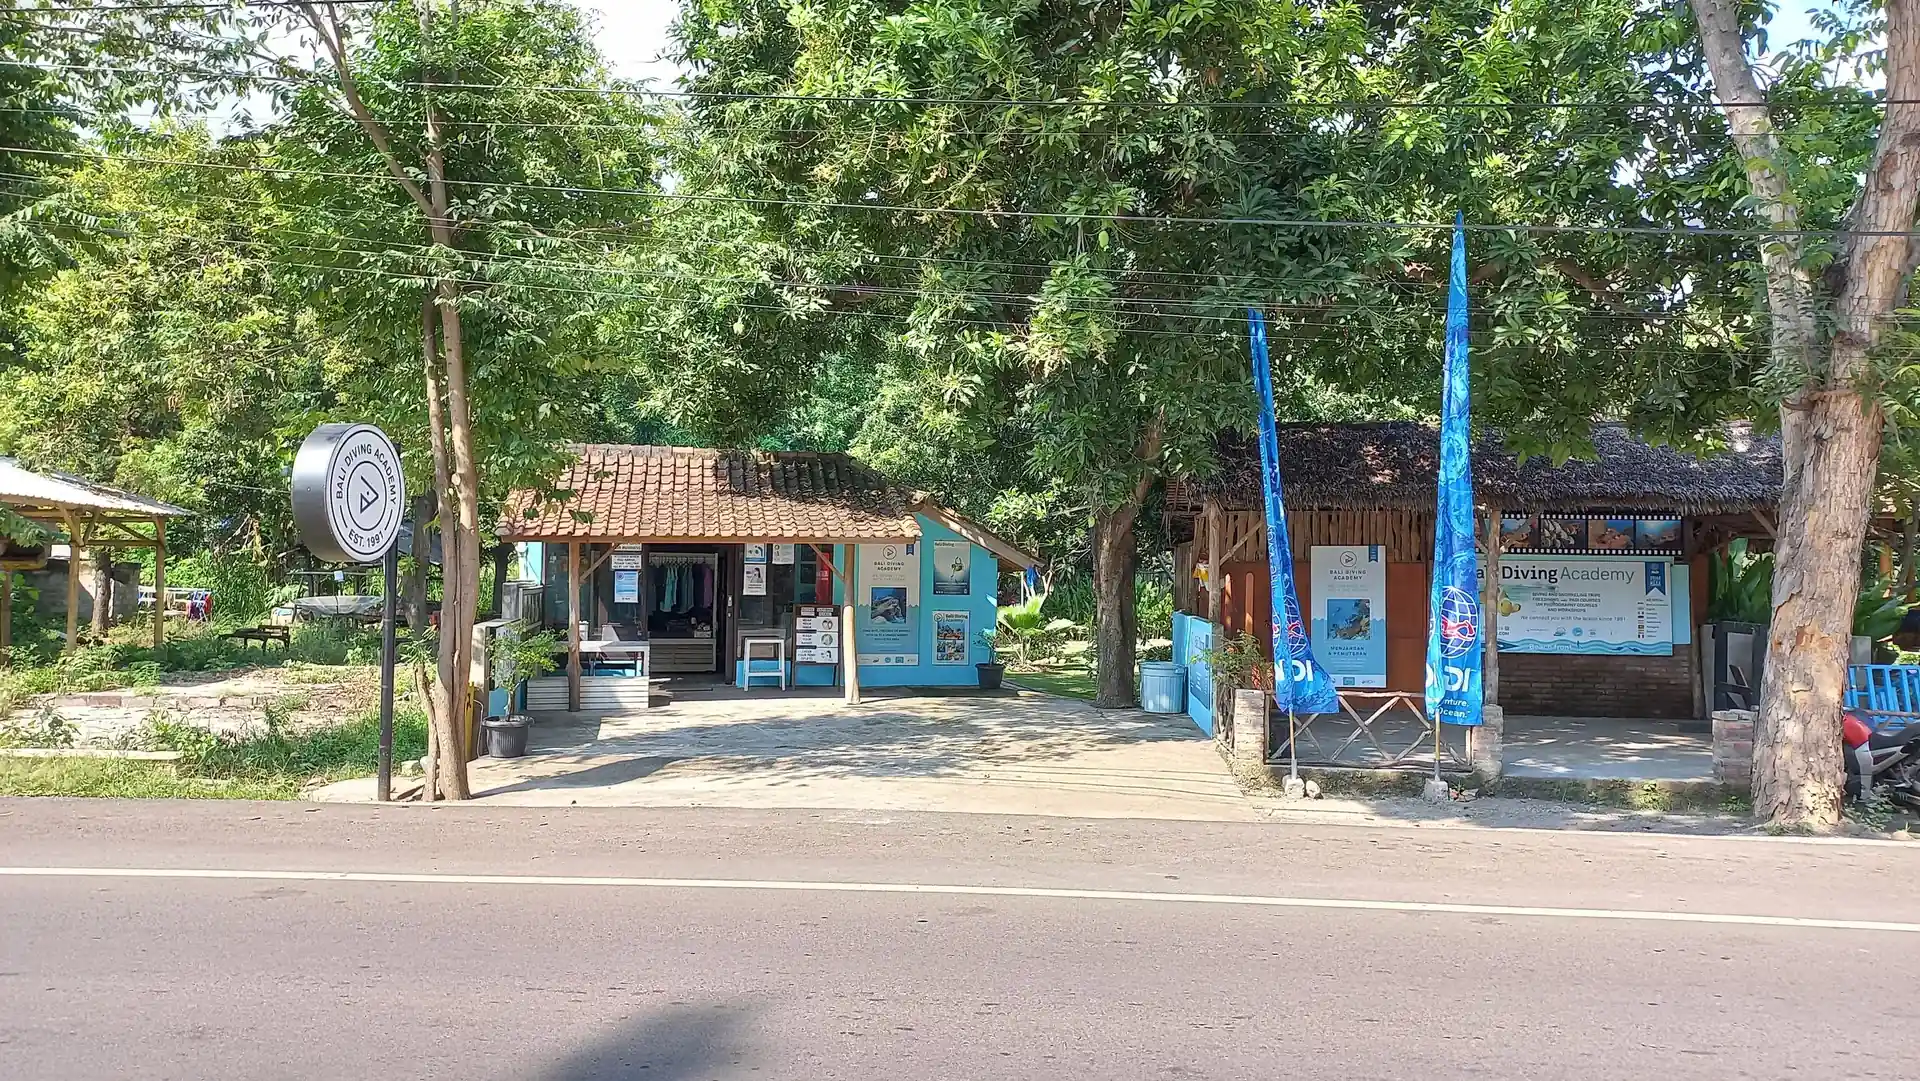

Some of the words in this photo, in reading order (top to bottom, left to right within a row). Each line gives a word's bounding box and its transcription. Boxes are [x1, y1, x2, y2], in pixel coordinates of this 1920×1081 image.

[336, 467, 347, 499] BALI
[344, 444, 372, 467] DIVING
[374, 448, 397, 505] ACADEMY
[348, 529, 365, 547] EST.
[366, 530, 384, 548] 1991
[1502, 565, 1558, 584] Diving
[1560, 566, 1635, 585] Academy
